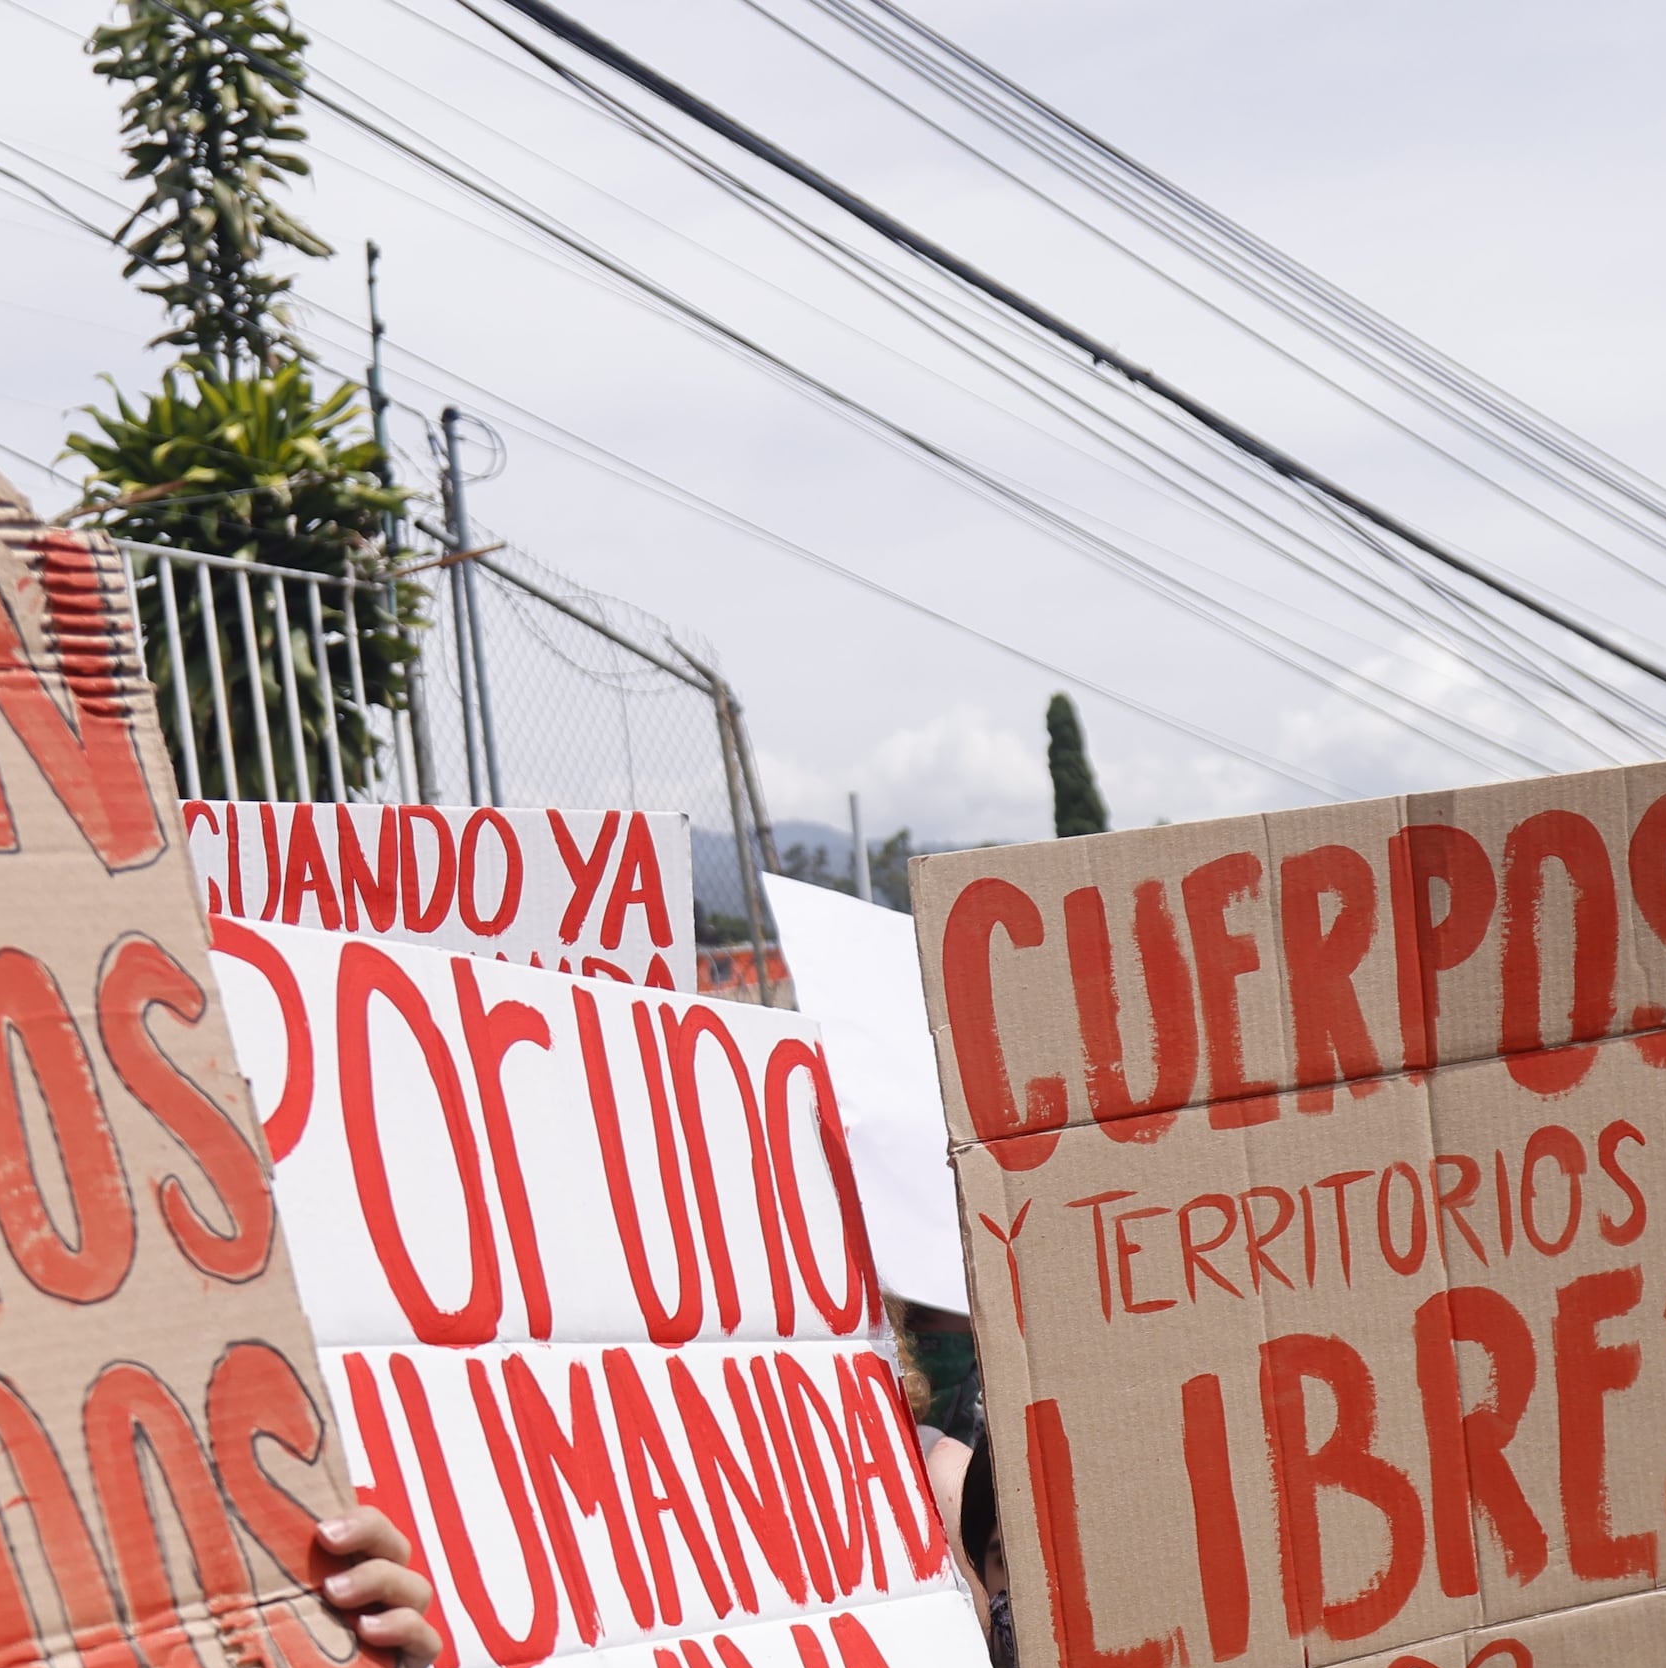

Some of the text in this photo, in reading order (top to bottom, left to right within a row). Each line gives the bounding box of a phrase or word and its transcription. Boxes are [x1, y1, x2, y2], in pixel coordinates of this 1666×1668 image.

[546, 807, 674, 950] YA
[572, 983, 883, 1346] una
[978, 1118, 1648, 1338] Y TERRITORIOS
